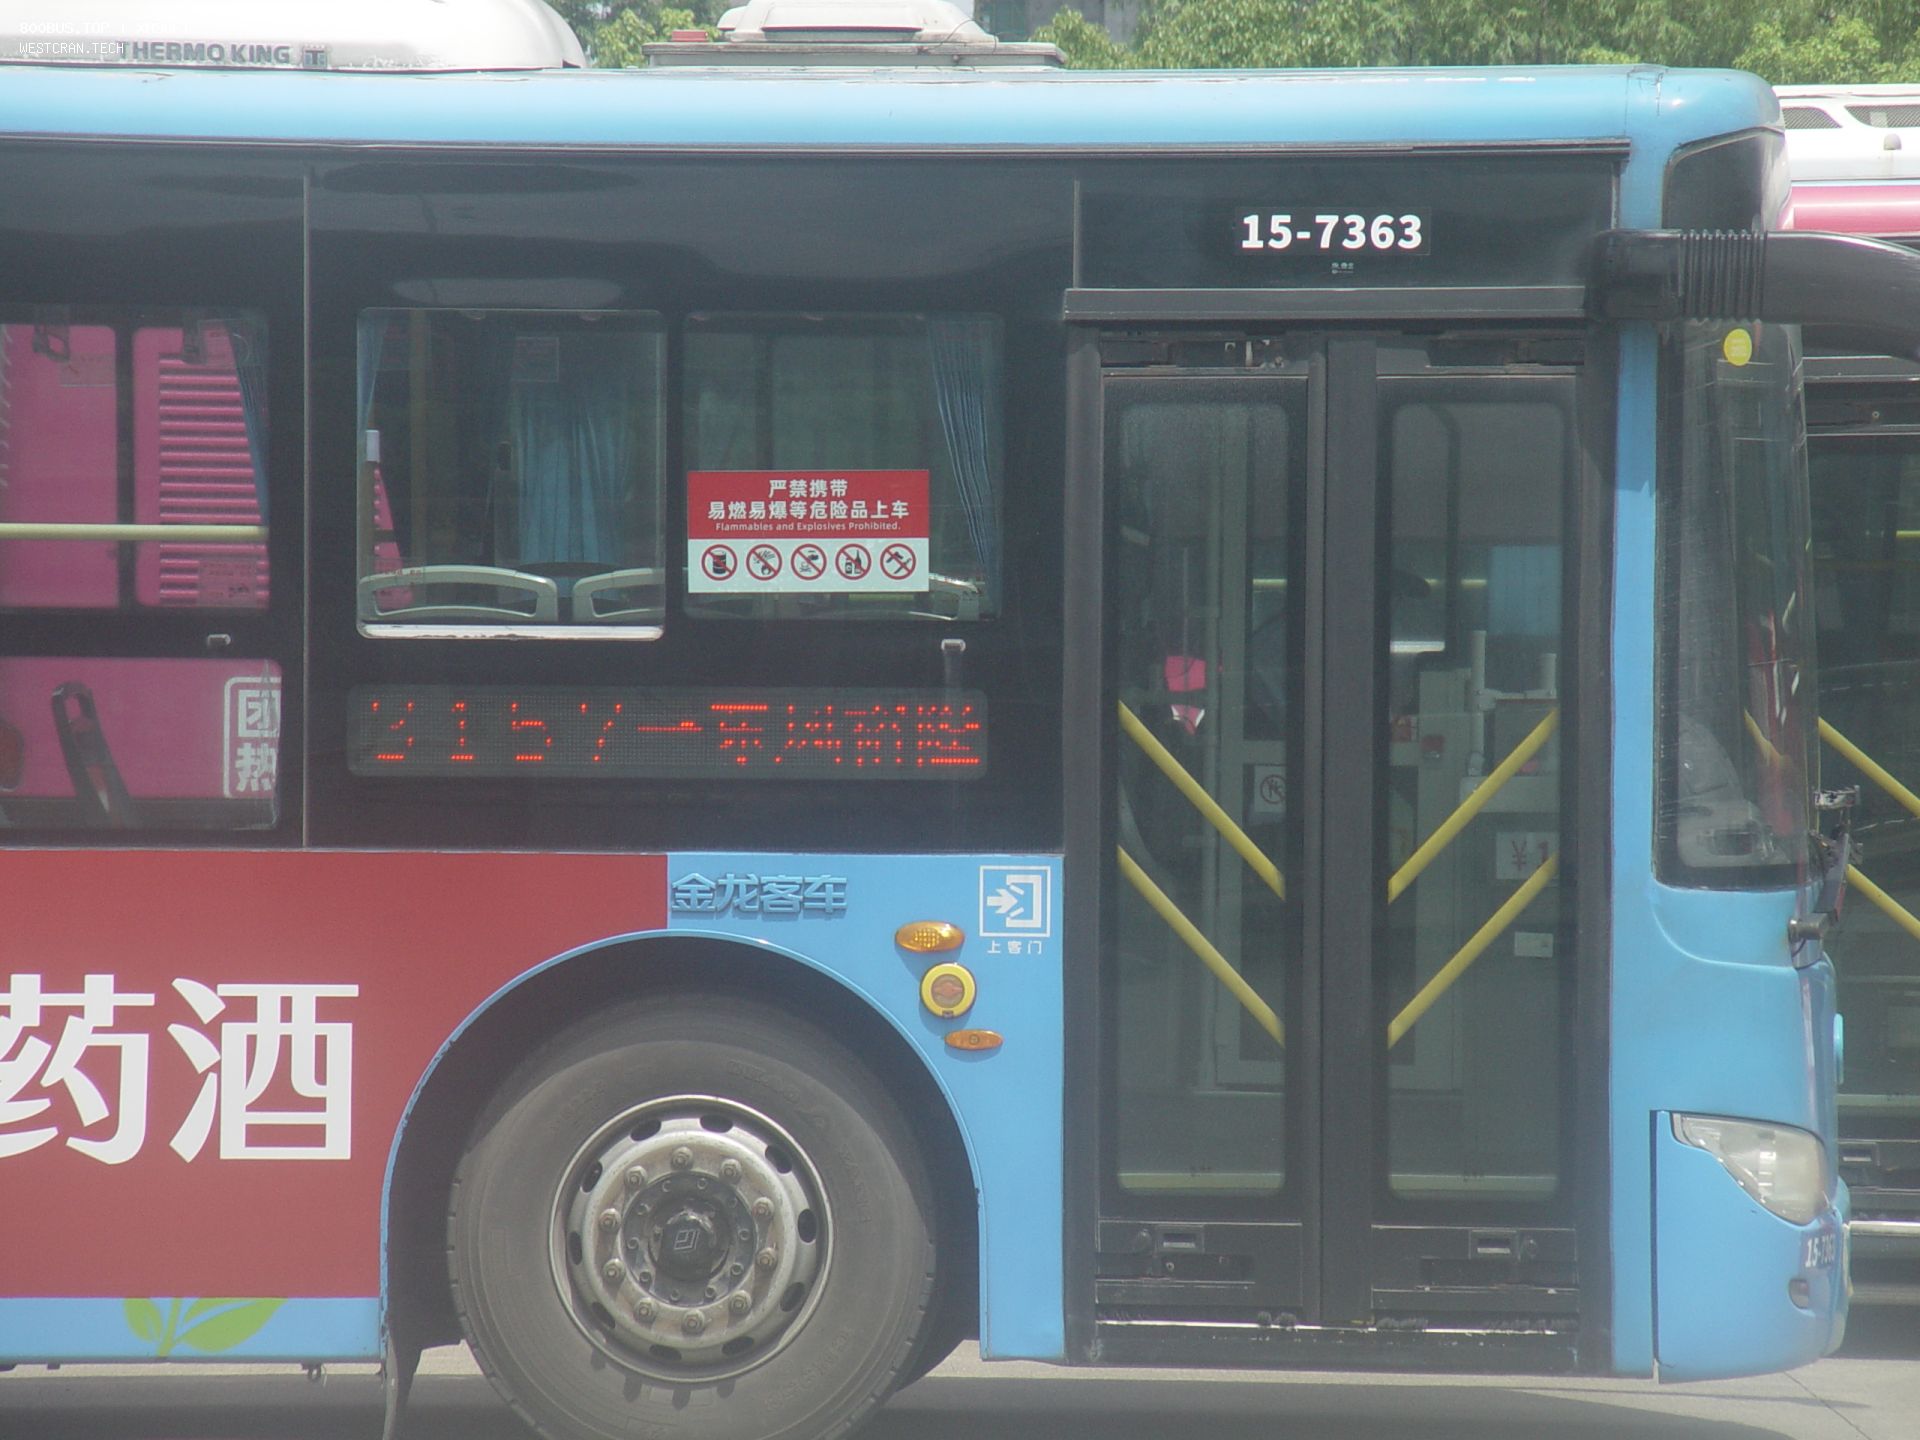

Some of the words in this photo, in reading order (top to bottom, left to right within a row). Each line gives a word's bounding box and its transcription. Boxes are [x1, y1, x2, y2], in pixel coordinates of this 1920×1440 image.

[116, 41, 225, 62] THERMO
[230, 43, 291, 64] KING
[1242, 213, 1422, 249] 15-7363
[768, 479, 848, 498] 严禁携带
[707, 500, 909, 520] 易燃易爆等危险品上车
[715, 522, 773, 531] Flammables
[776, 522, 794, 531] and
[796, 522, 846, 533] Explosives
[671, 872, 849, 915] 金龙客车
[987, 940, 1043, 955] 上客门
[0, 974, 360, 1165] 药酒
